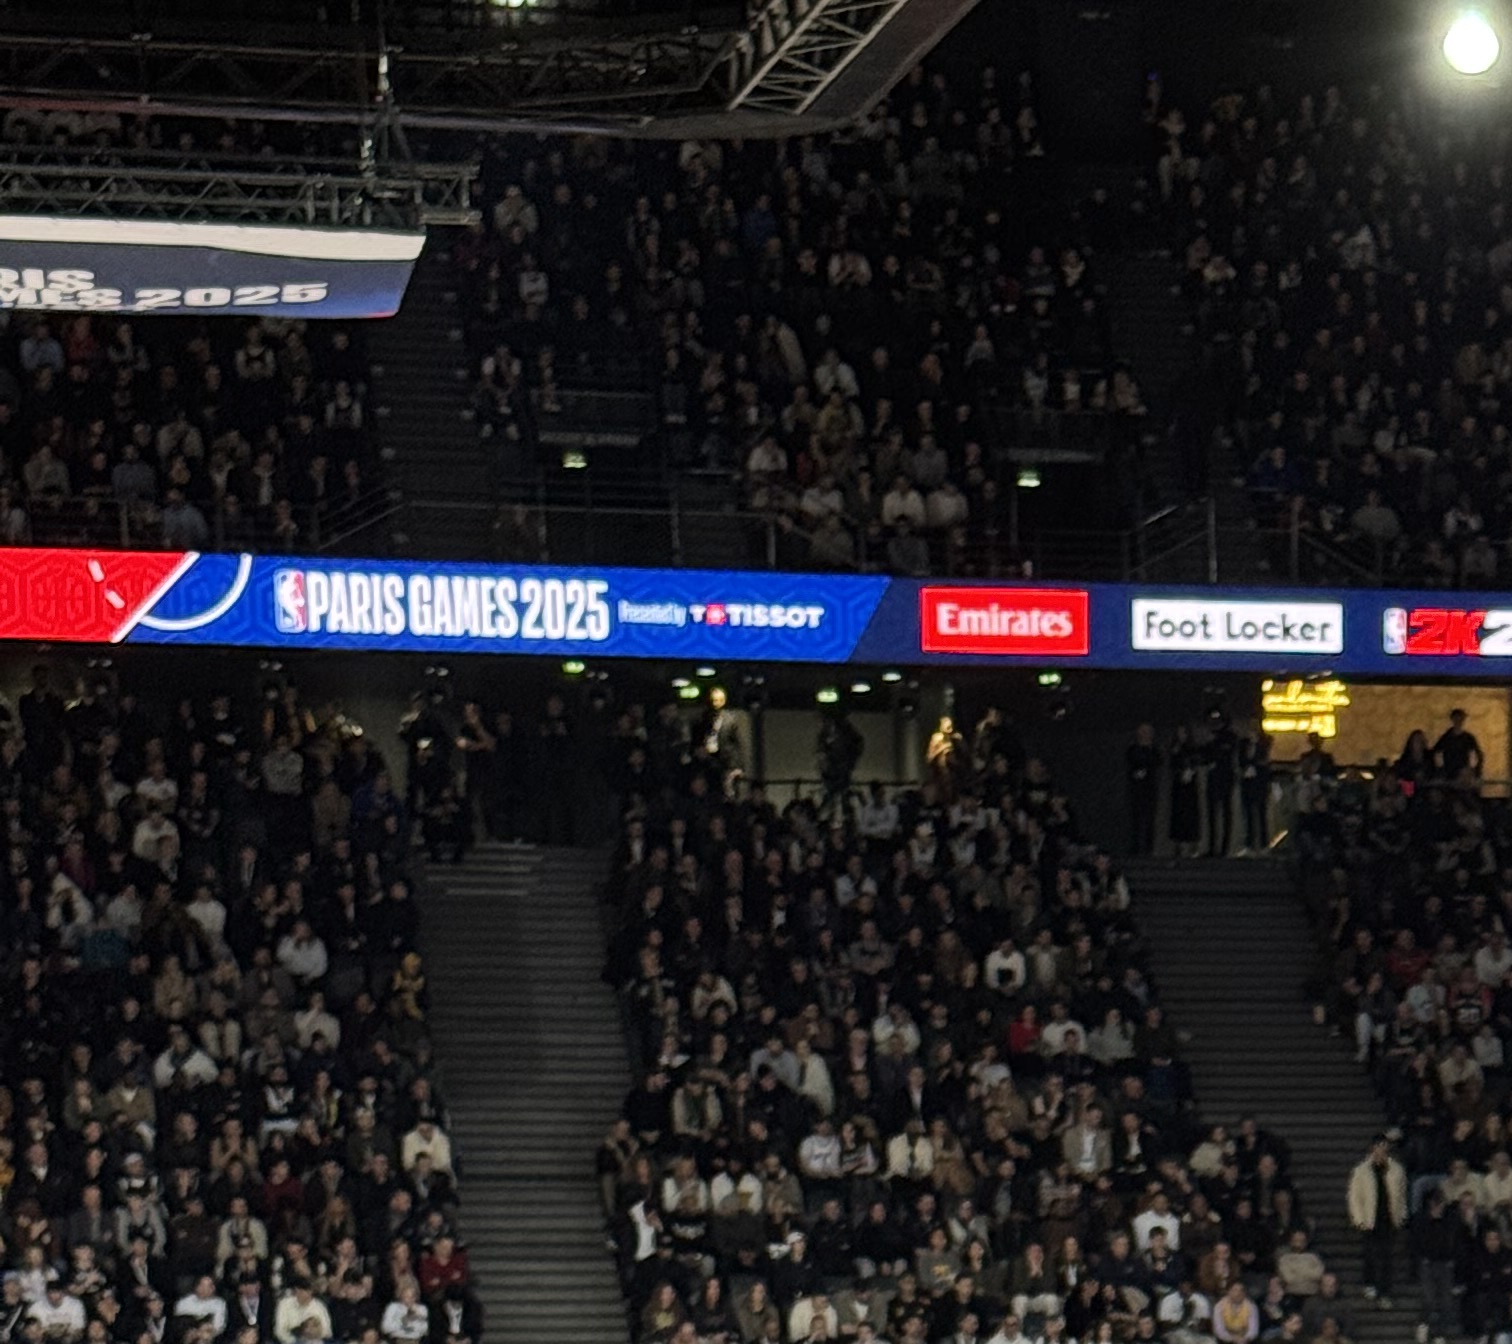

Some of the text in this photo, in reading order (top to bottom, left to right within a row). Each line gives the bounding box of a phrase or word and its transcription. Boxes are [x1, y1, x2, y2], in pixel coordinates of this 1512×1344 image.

[135, 282, 329, 308] 2025
[306, 571, 611, 641] PARIS GAMES 2025
[725, 603, 825, 629] TISSOT
[936, 602, 1073, 637] Emirates
[1145, 611, 1333, 642] Foot Locker
